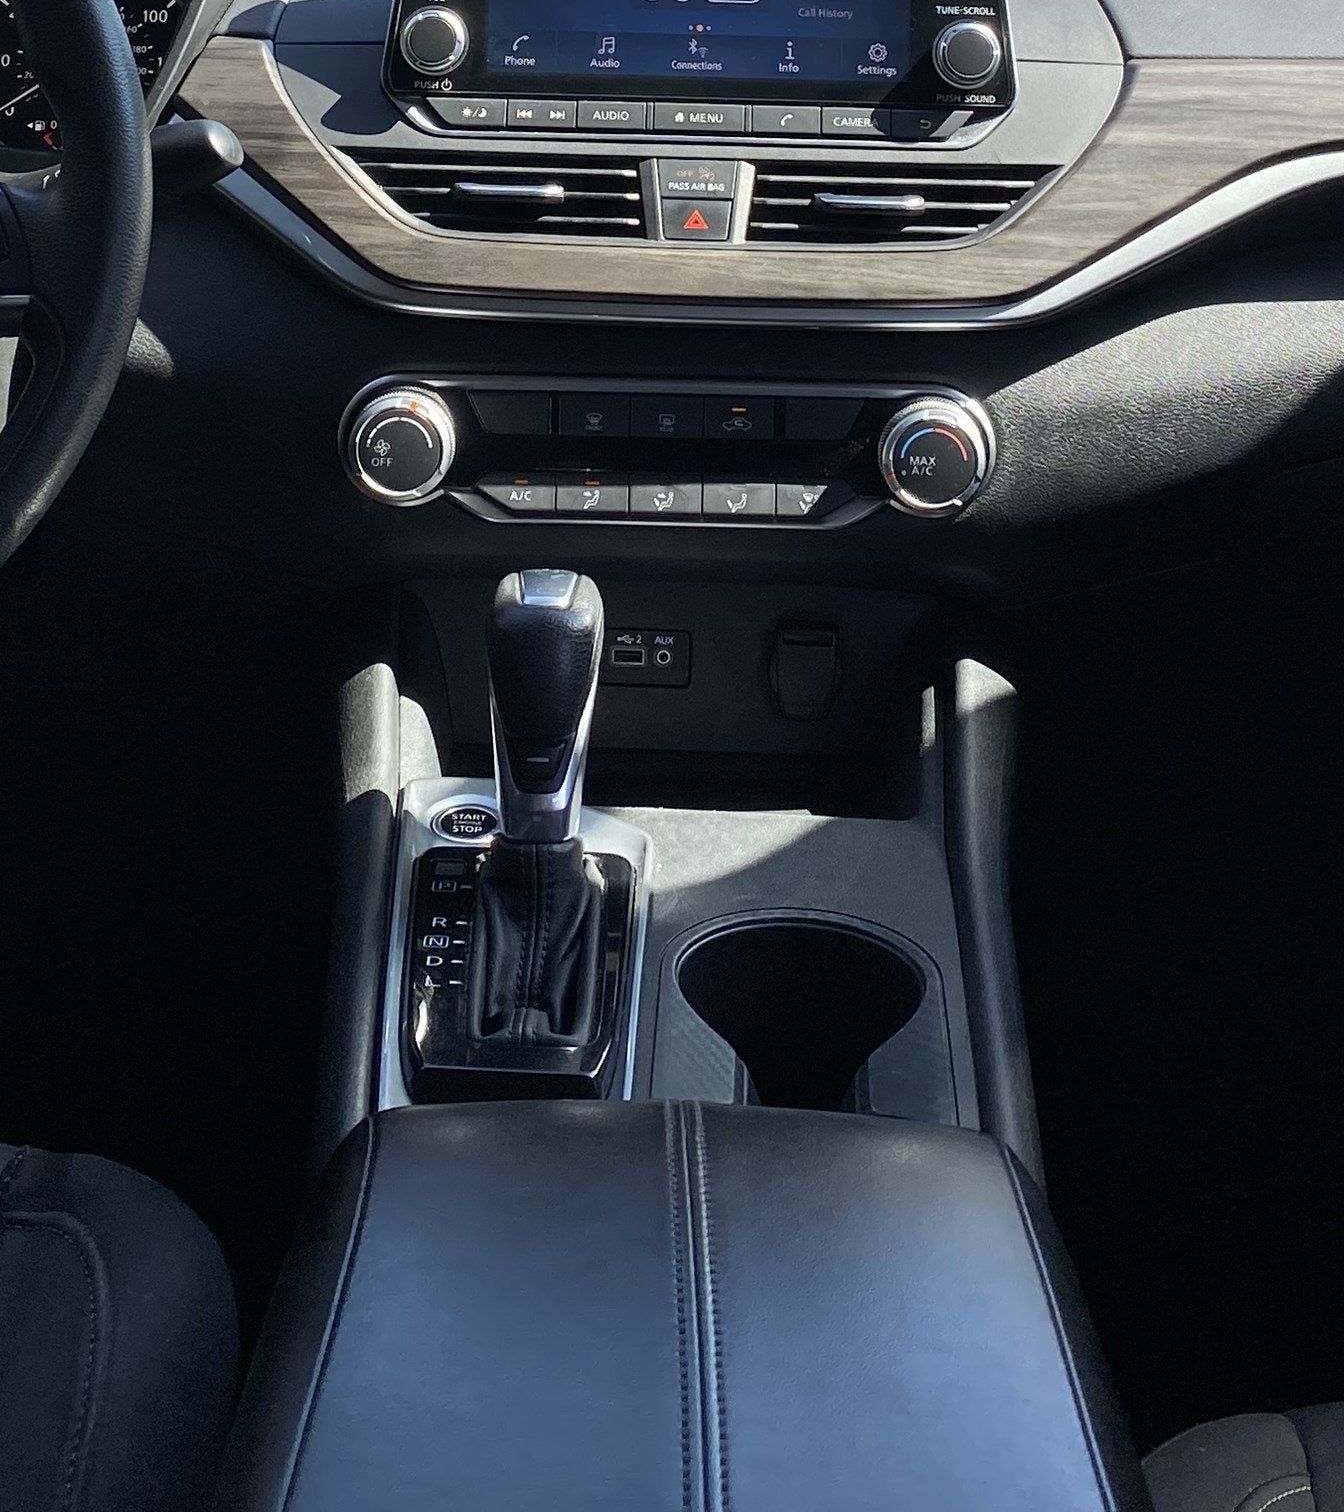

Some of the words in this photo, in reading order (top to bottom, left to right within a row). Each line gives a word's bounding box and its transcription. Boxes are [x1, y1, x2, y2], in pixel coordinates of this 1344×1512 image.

[143, 9, 169, 24] 100
[798, 7, 817, 19] Call
[819, 8, 854, 21] History
[504, 55, 536, 67] Phone
[590, 57, 621, 69] Audio
[670, 59, 723, 72] Connections
[778, 62, 800, 74] Info
[856, 64, 898, 78] Settings
[414, 80, 439, 89] PUSH
[936, 94, 960, 104] PUSH
[964, 94, 996, 105] SOUND
[592, 110, 630, 121] AUDIO
[688, 112, 724, 124] MENU
[832, 116, 879, 128] CAMERA
[668, 181, 691, 192] PASS
[692, 182, 707, 193] AIR
[708, 183, 726, 194] BAG
[370, 457, 394, 468] OFF
[908, 455, 937, 467] MAX
[910, 467, 933, 477] A/C
[509, 489, 532, 502] A/C
[654, 635, 676, 646] AUX
[451, 812, 486, 822] START
[452, 824, 484, 834] STOP
[432, 916, 448, 928] R
[430, 936, 445, 947] N
[425, 955, 444, 967] D
